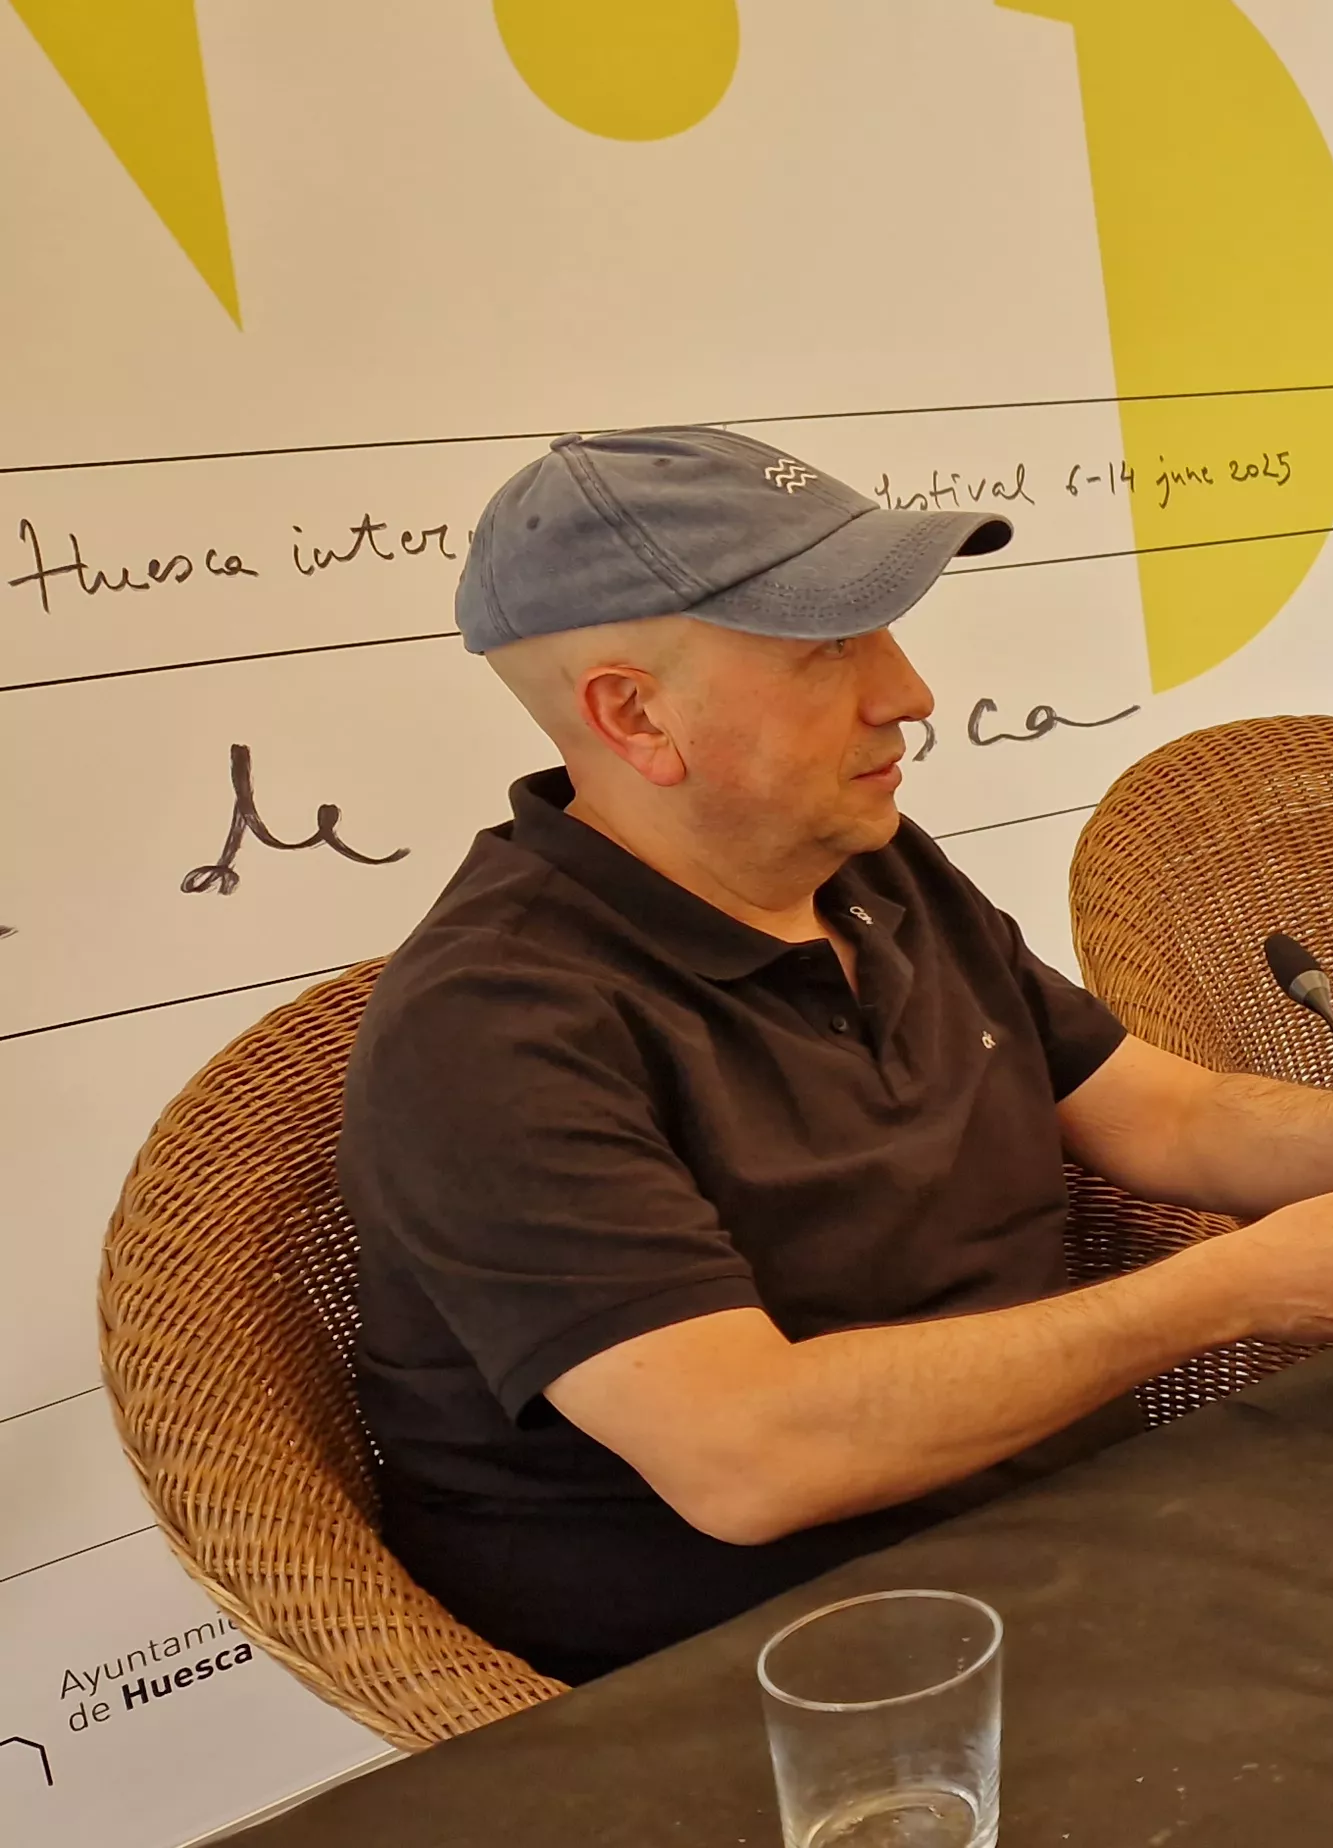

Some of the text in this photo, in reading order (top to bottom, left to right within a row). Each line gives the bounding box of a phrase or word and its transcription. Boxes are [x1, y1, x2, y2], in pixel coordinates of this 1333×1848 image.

[9, 518, 259, 614] Huesca
[1156, 455, 1214, 509] june
[1229, 451, 1292, 486] 2025
[69, 1643, 253, 1732] de Huesca
